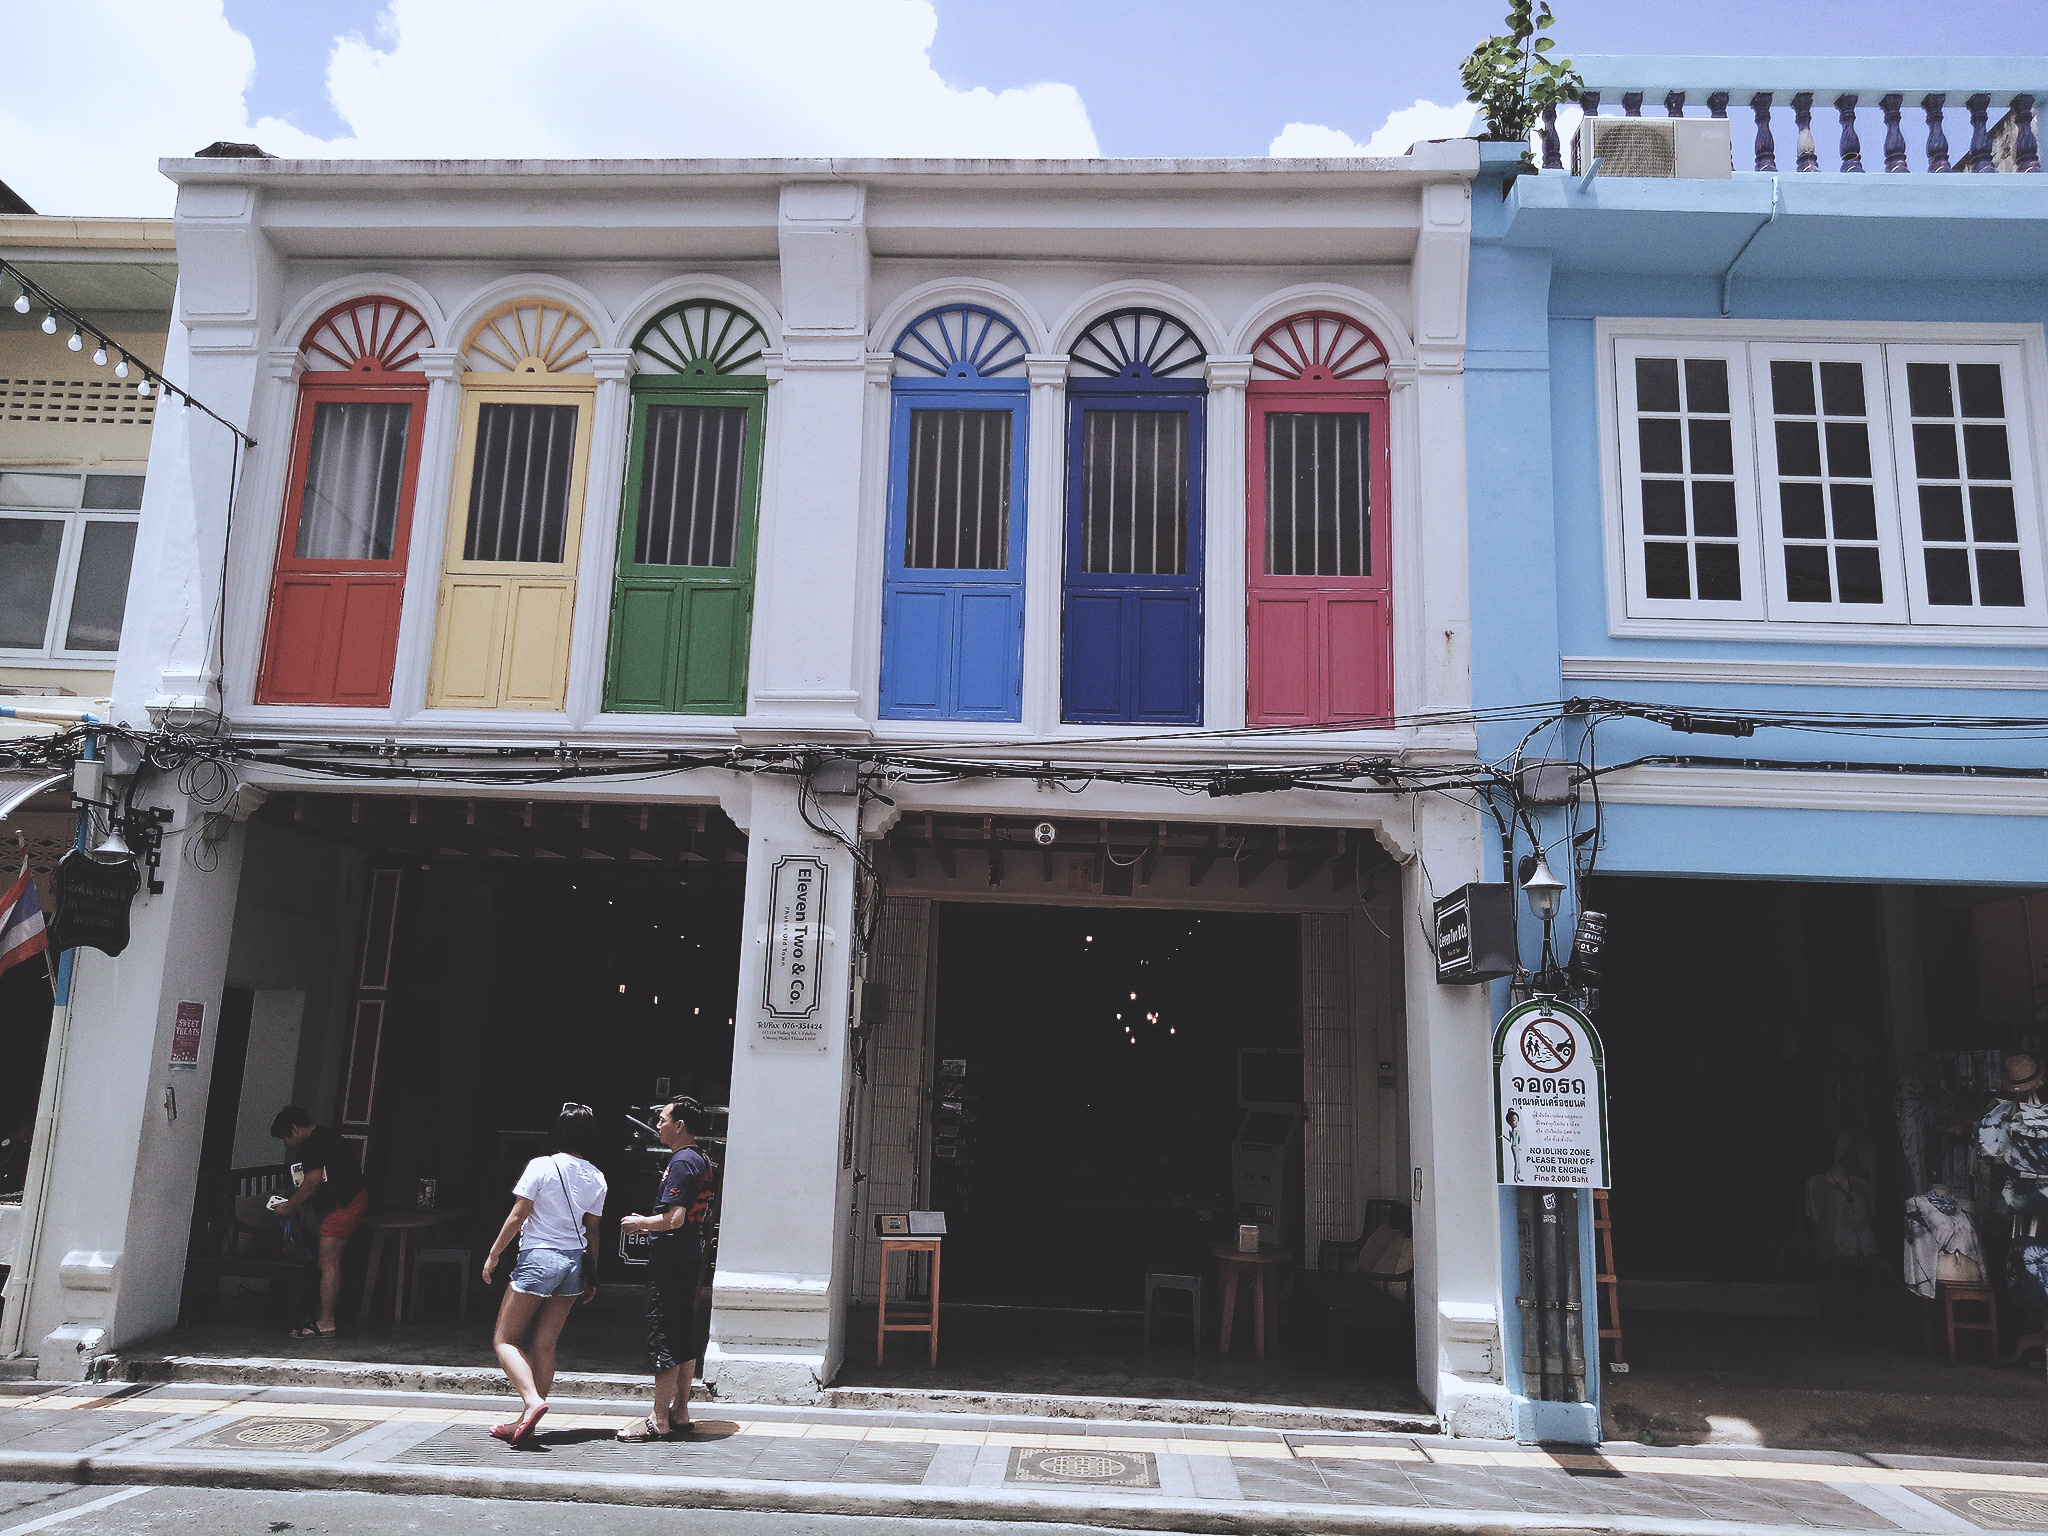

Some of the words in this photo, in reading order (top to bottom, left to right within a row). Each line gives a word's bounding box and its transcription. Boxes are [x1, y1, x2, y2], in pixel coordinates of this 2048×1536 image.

[795, 868, 812, 922] Eleven
[792, 926, 808, 959] Two
[791, 962, 806, 975] &
[789, 980, 805, 1004] Co.
[178, 1018, 200, 1028] SWEET
[176, 1027, 200, 1036] TREATS
[1512, 1076, 1586, 1094] จอดรถ
[1512, 1094, 1586, 1109] กรุณาดับเครื่องยนต์
